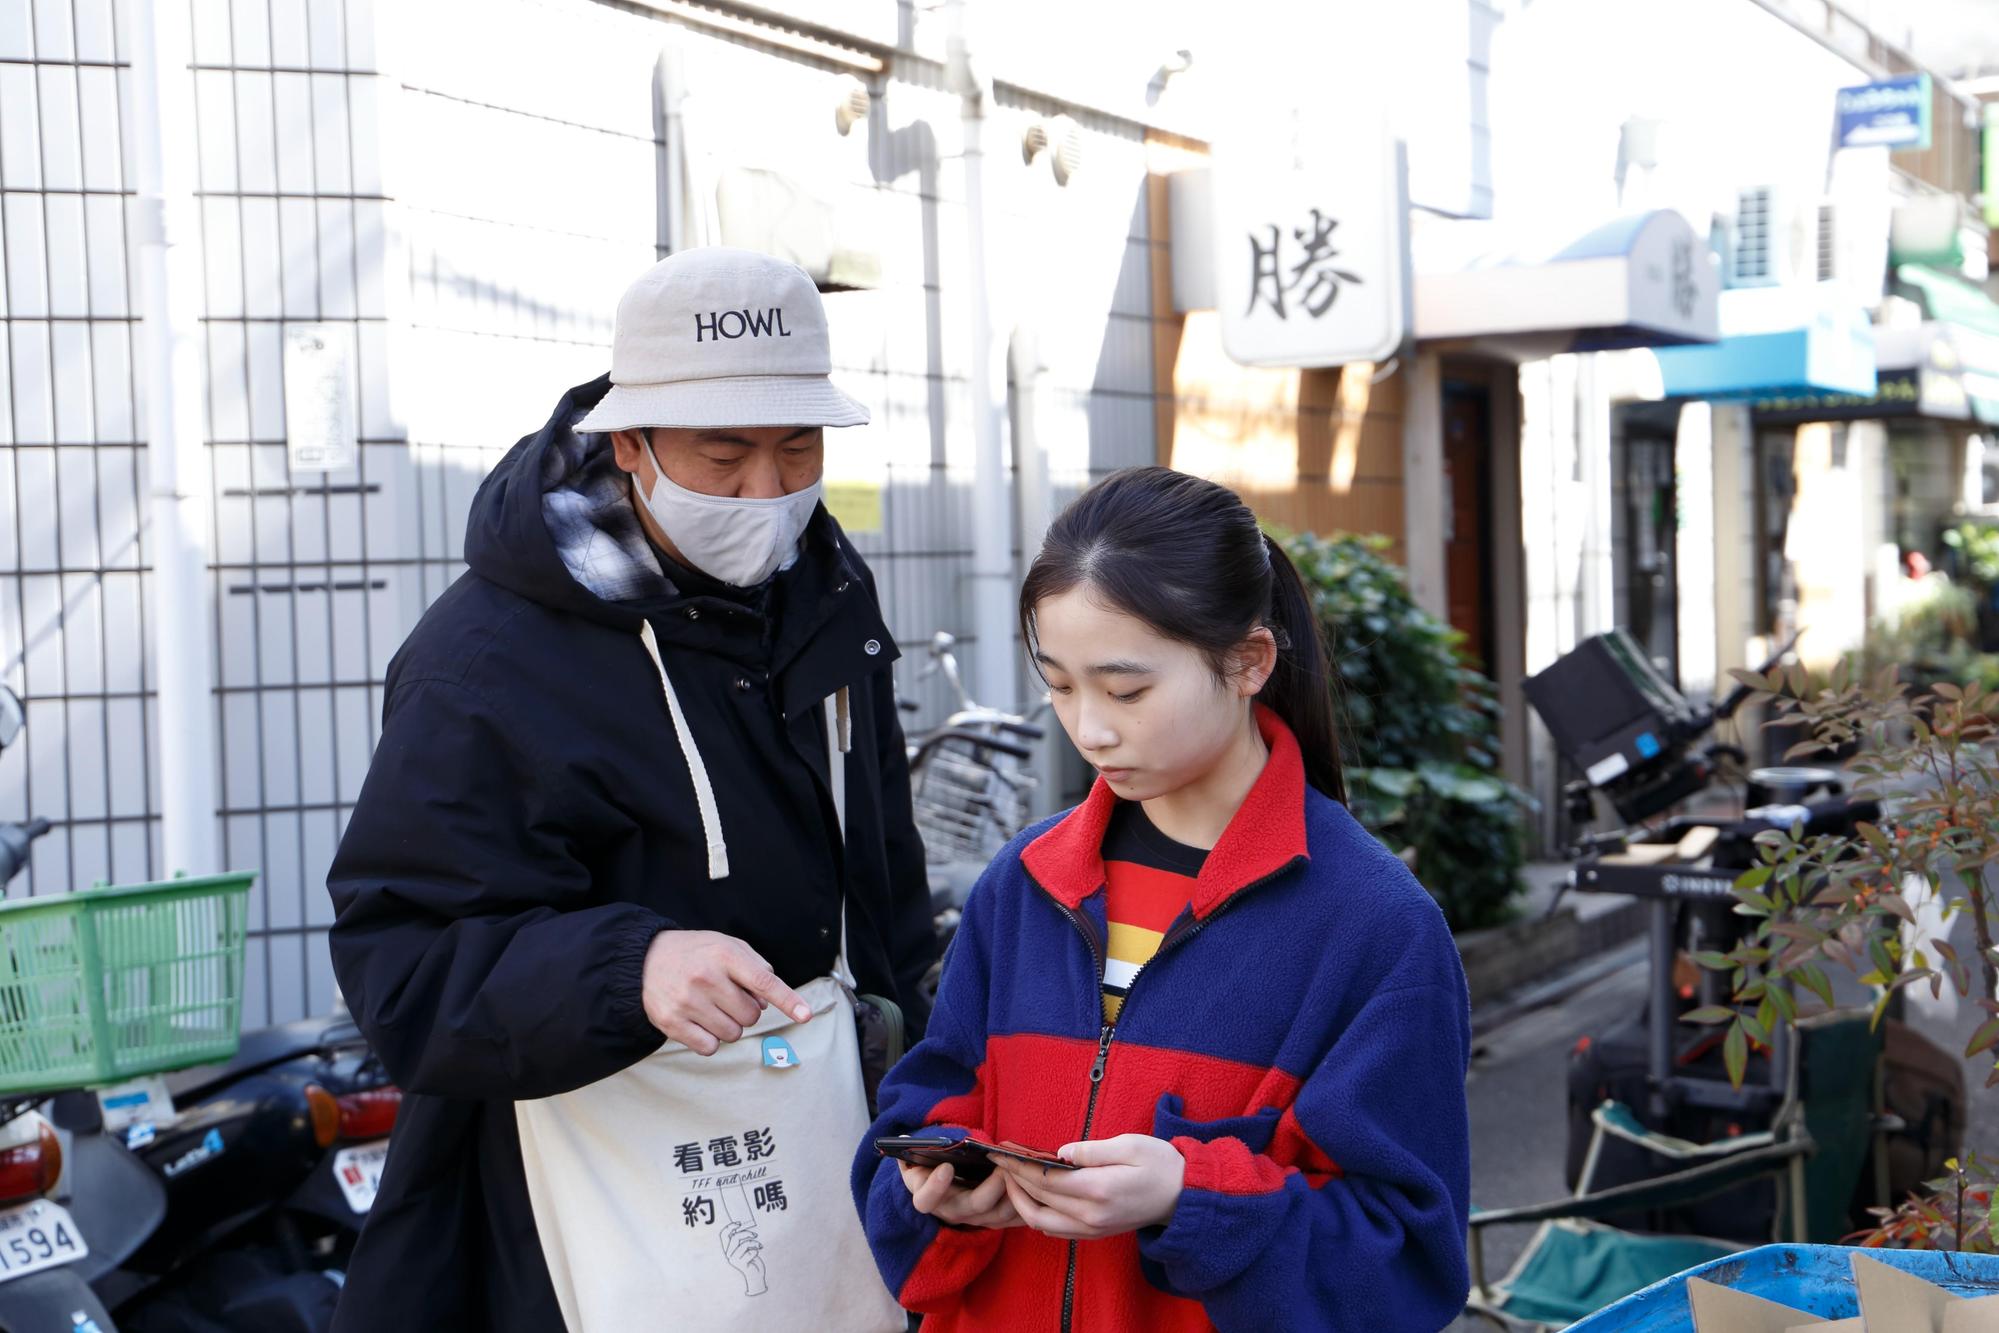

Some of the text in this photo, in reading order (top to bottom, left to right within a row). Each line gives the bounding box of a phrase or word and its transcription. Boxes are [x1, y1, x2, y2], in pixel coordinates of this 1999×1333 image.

[1246, 207, 1364, 321] 勝
[694, 308, 791, 342] HOWL
[672, 1126, 776, 1174] 看電影
[692, 1166, 767, 1190] TFF and chill
[682, 1180, 788, 1228] 約 嗎
